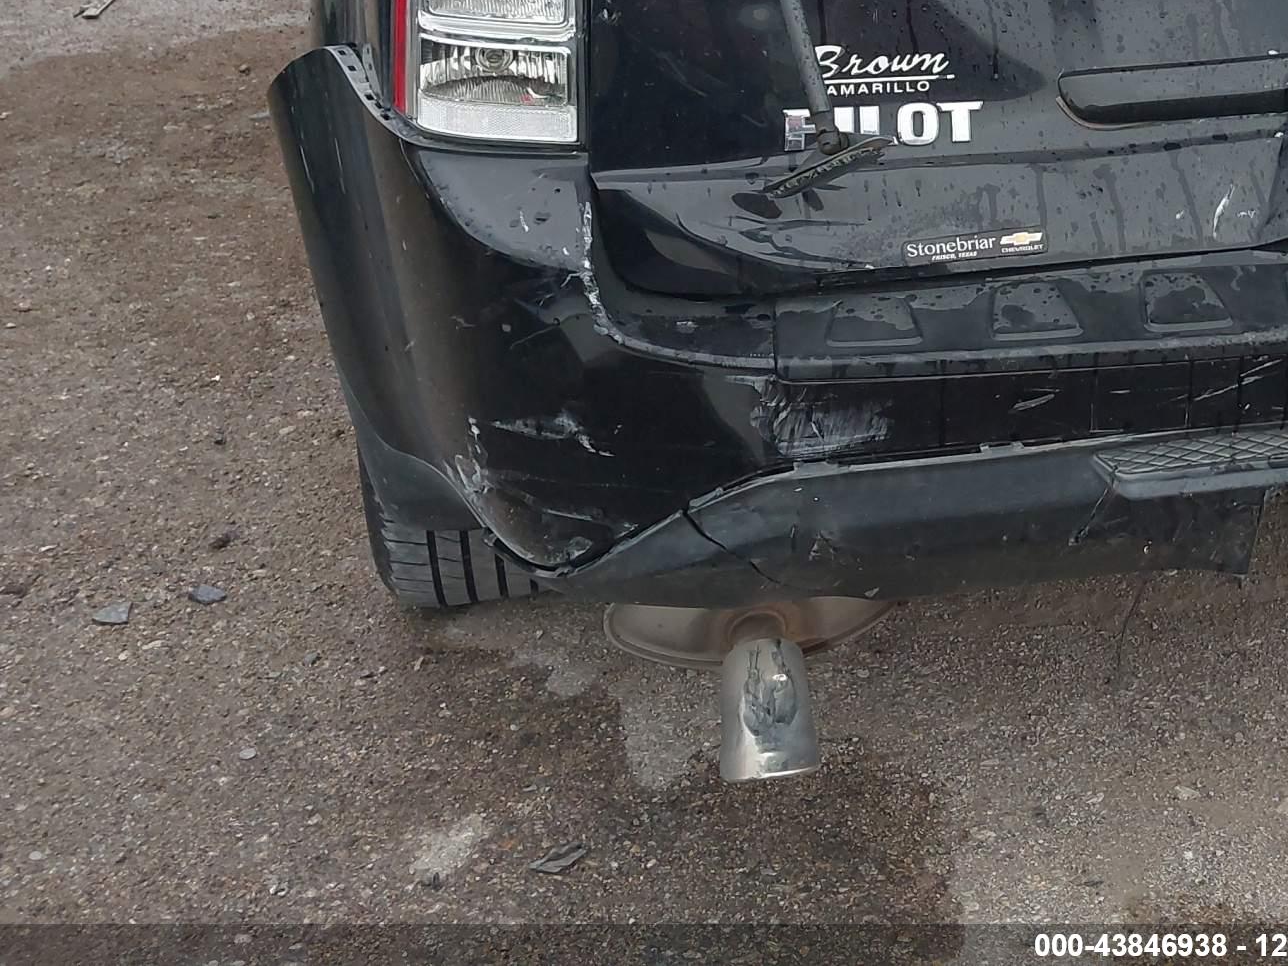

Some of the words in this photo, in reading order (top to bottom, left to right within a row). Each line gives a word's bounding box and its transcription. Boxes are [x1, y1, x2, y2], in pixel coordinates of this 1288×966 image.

[827, 81, 931, 96] AMARILLO
[906, 235, 996, 258] Stonebriar
[1001, 244, 1044, 253] CHEVROLET
[958, 251, 978, 259] TEXAS
